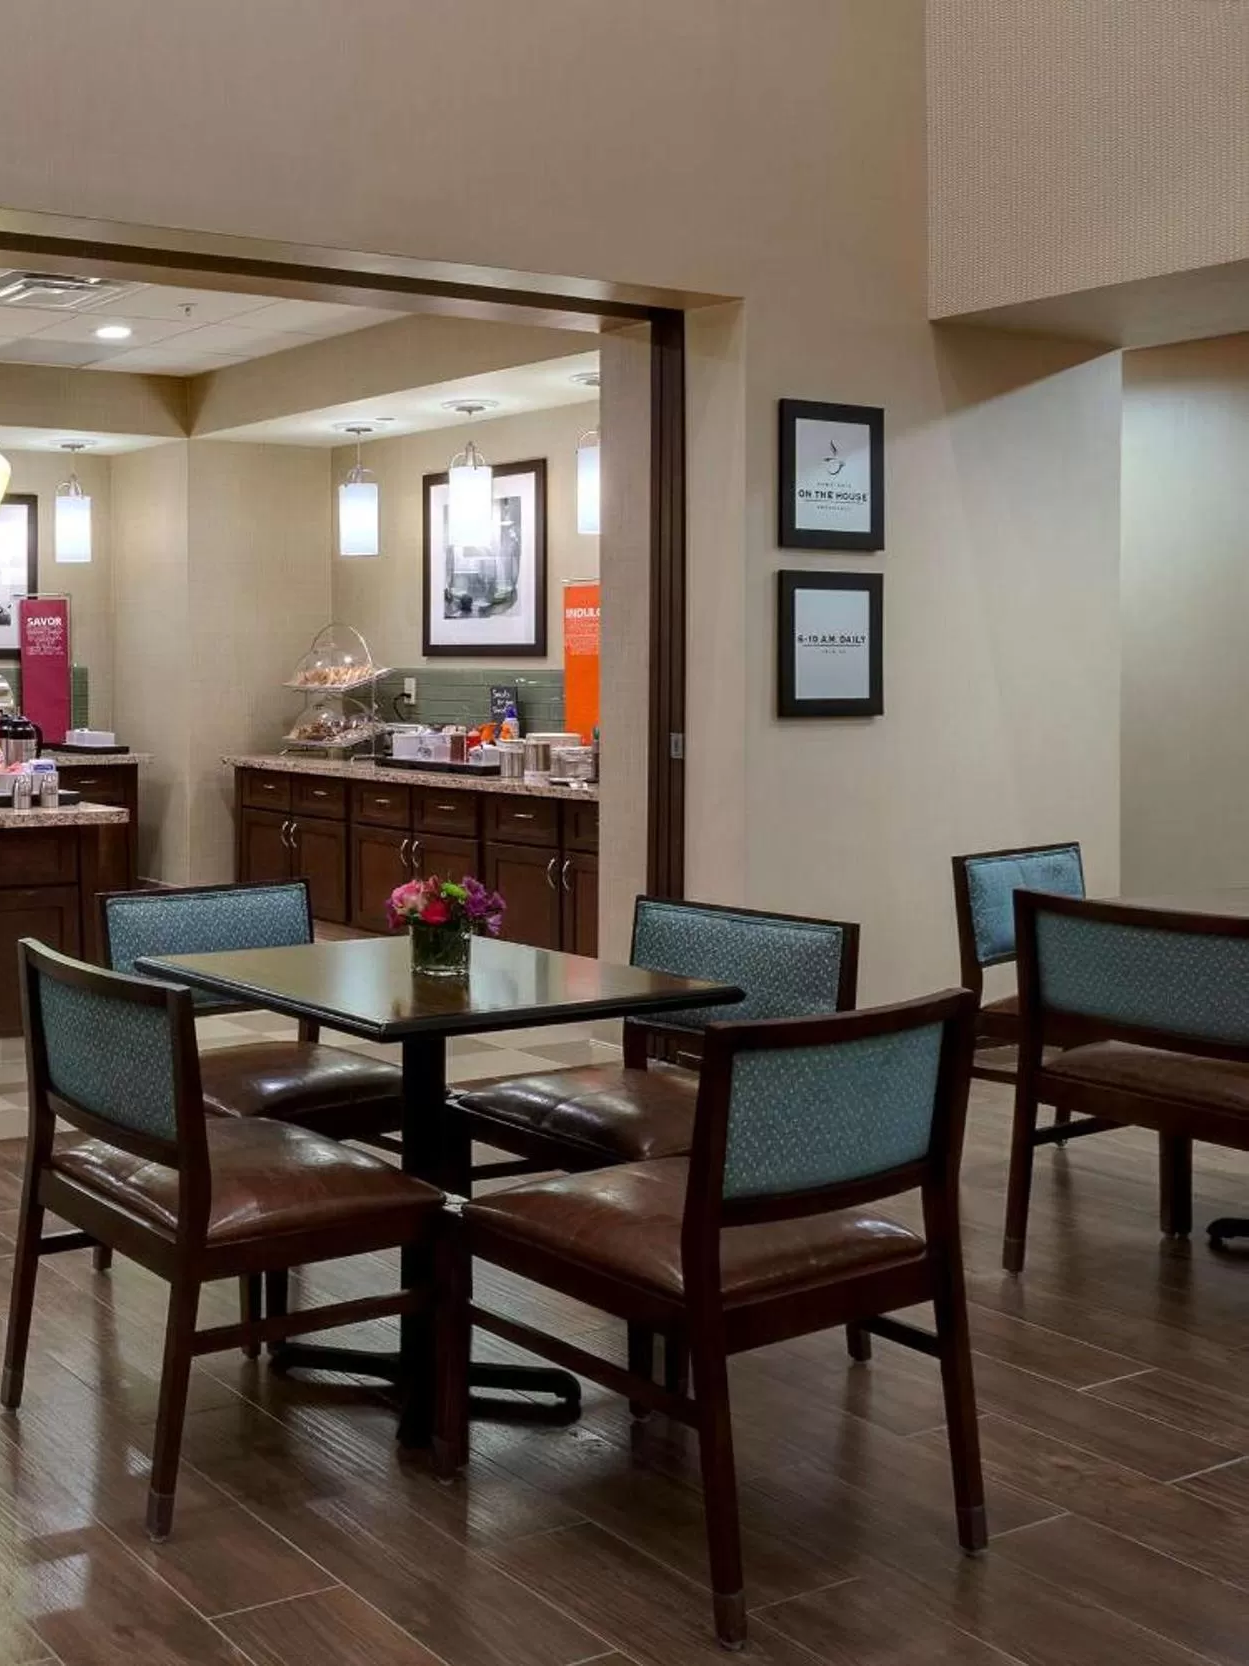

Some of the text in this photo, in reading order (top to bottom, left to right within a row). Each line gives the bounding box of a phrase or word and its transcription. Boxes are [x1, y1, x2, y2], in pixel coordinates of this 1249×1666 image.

[798, 489, 867, 502] ON THE HOUSE
[27, 617, 62, 626] SAVOR
[839, 635, 866, 644] DAILY
